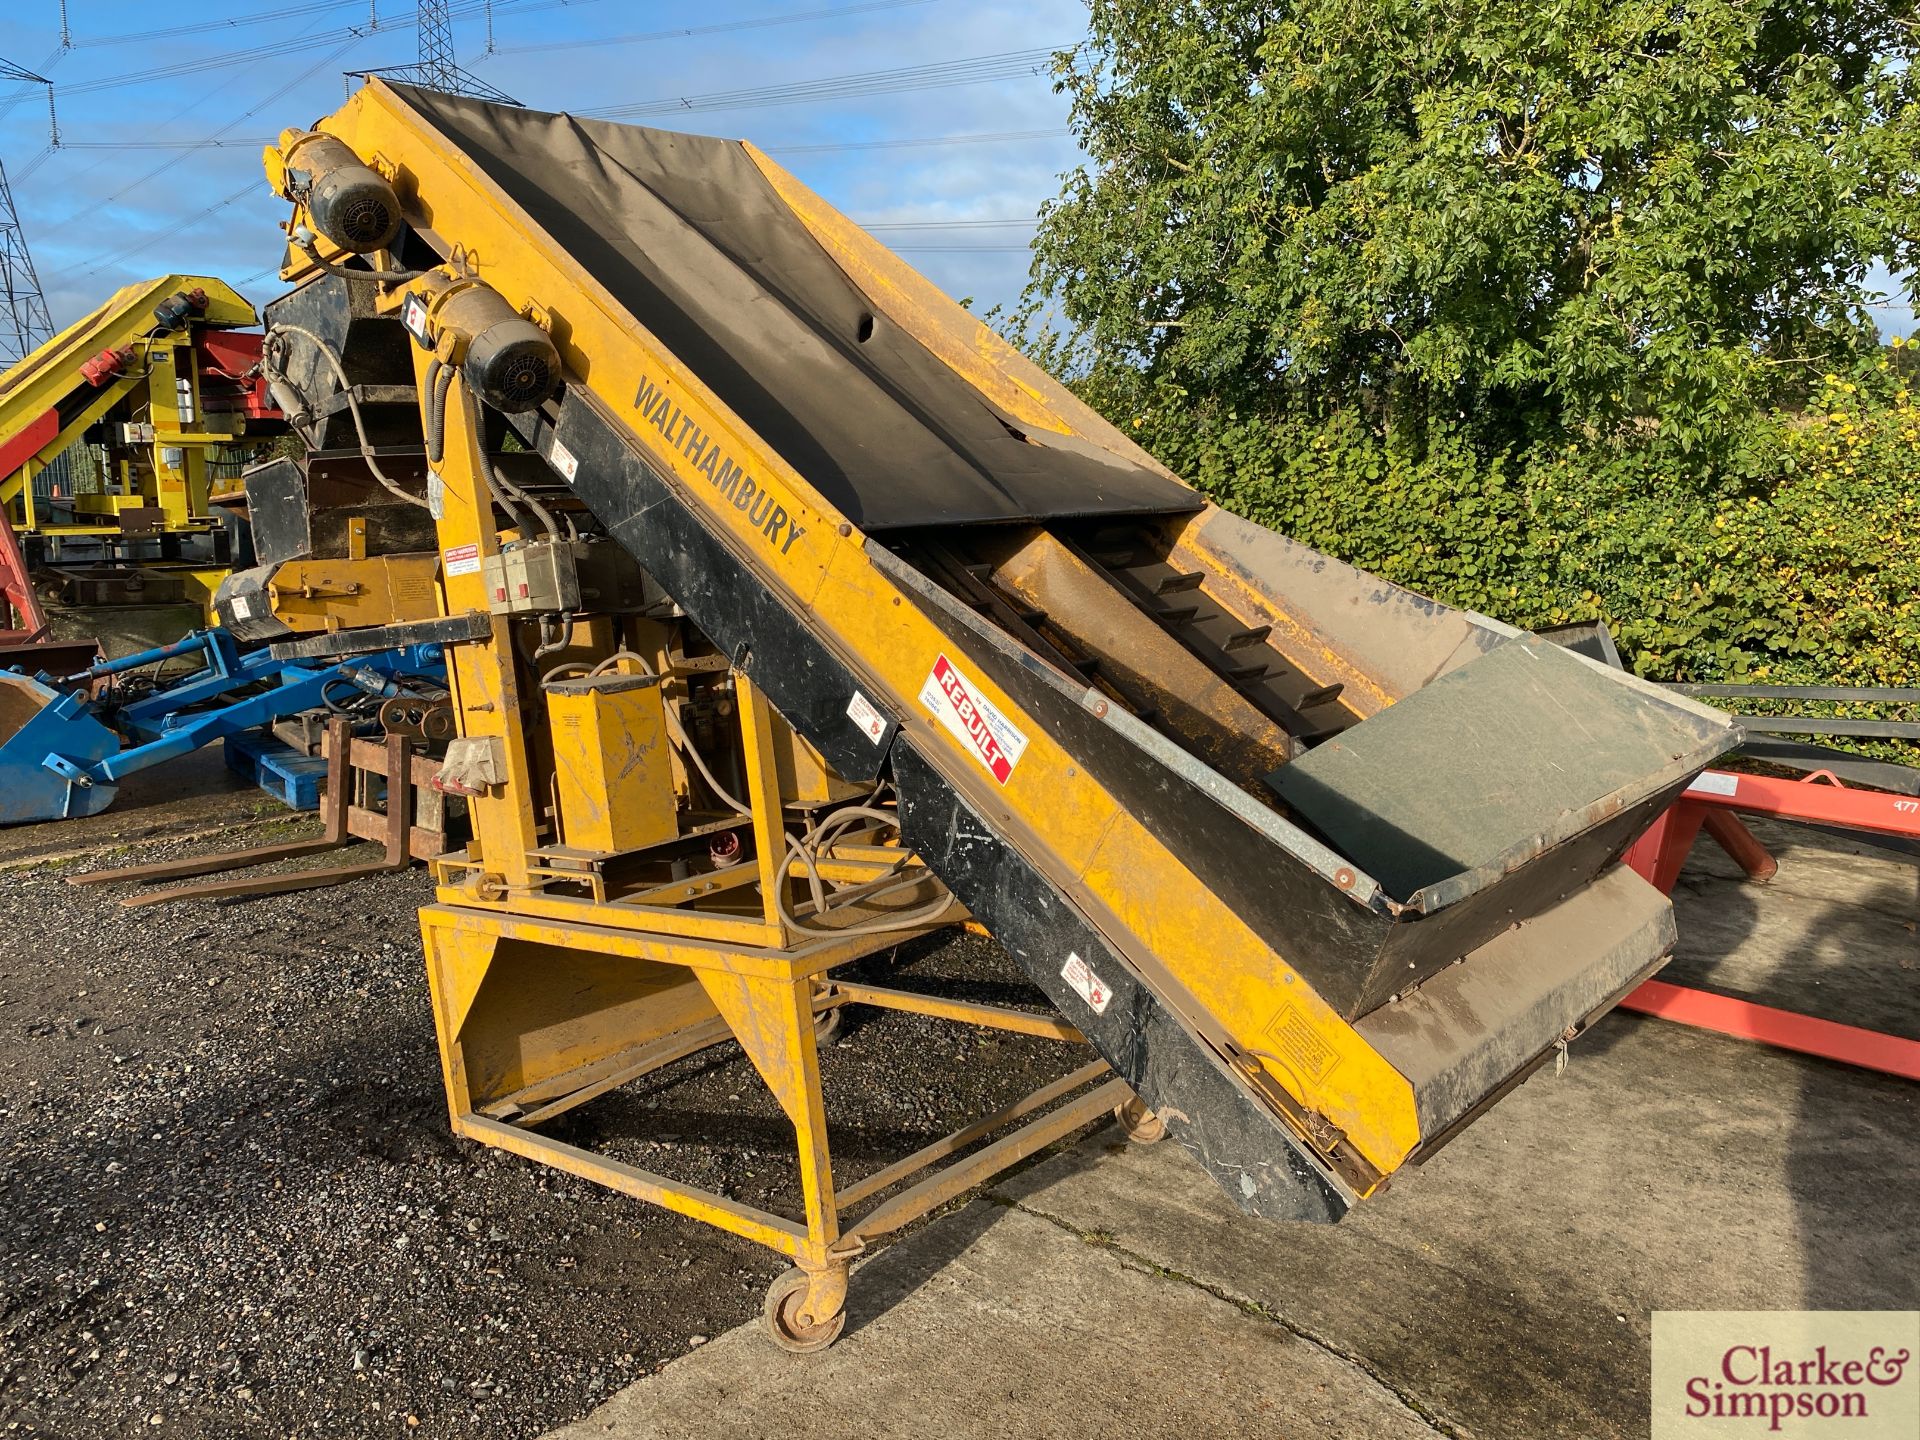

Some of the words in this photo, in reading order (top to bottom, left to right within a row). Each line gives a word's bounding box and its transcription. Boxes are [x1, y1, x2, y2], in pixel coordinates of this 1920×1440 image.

[634, 374, 806, 555] WALTHAMBURY
[940, 669, 1003, 766] REBUILT
[983, 704, 997, 720] DAVID
[998, 719, 1021, 744] HARRISON
[1894, 801, 1919, 813] 977
